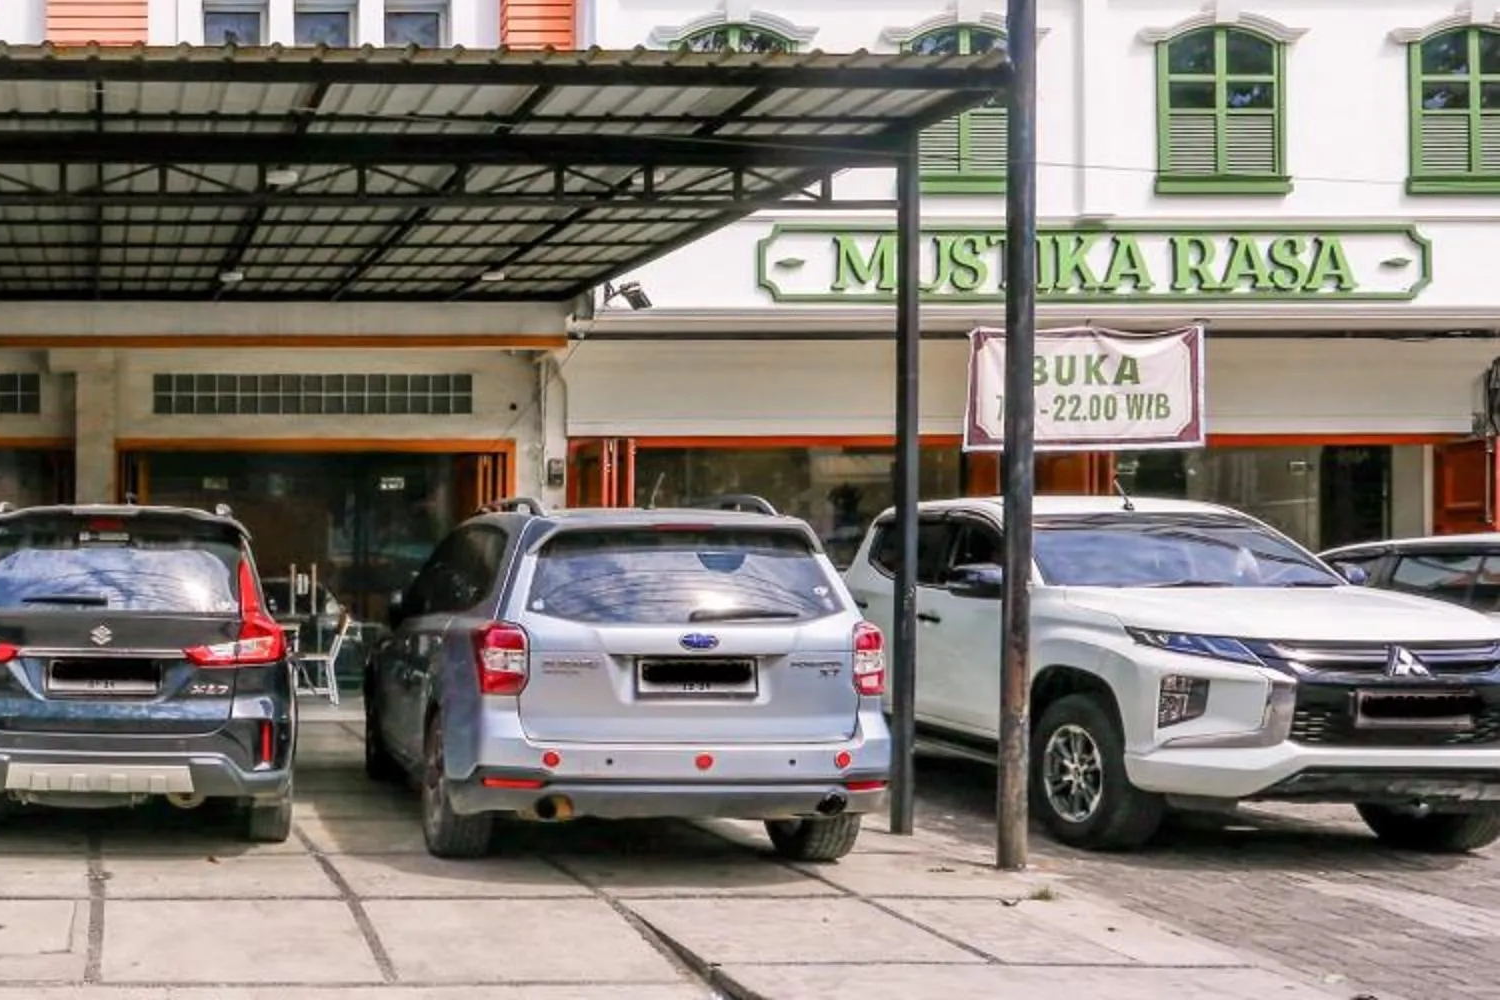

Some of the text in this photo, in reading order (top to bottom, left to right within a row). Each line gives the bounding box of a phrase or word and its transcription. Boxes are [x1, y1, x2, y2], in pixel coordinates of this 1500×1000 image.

[1168, 233, 1360, 291] RASA
[1032, 355, 1141, 387] BUKA
[1126, 392, 1171, 419] WIB
